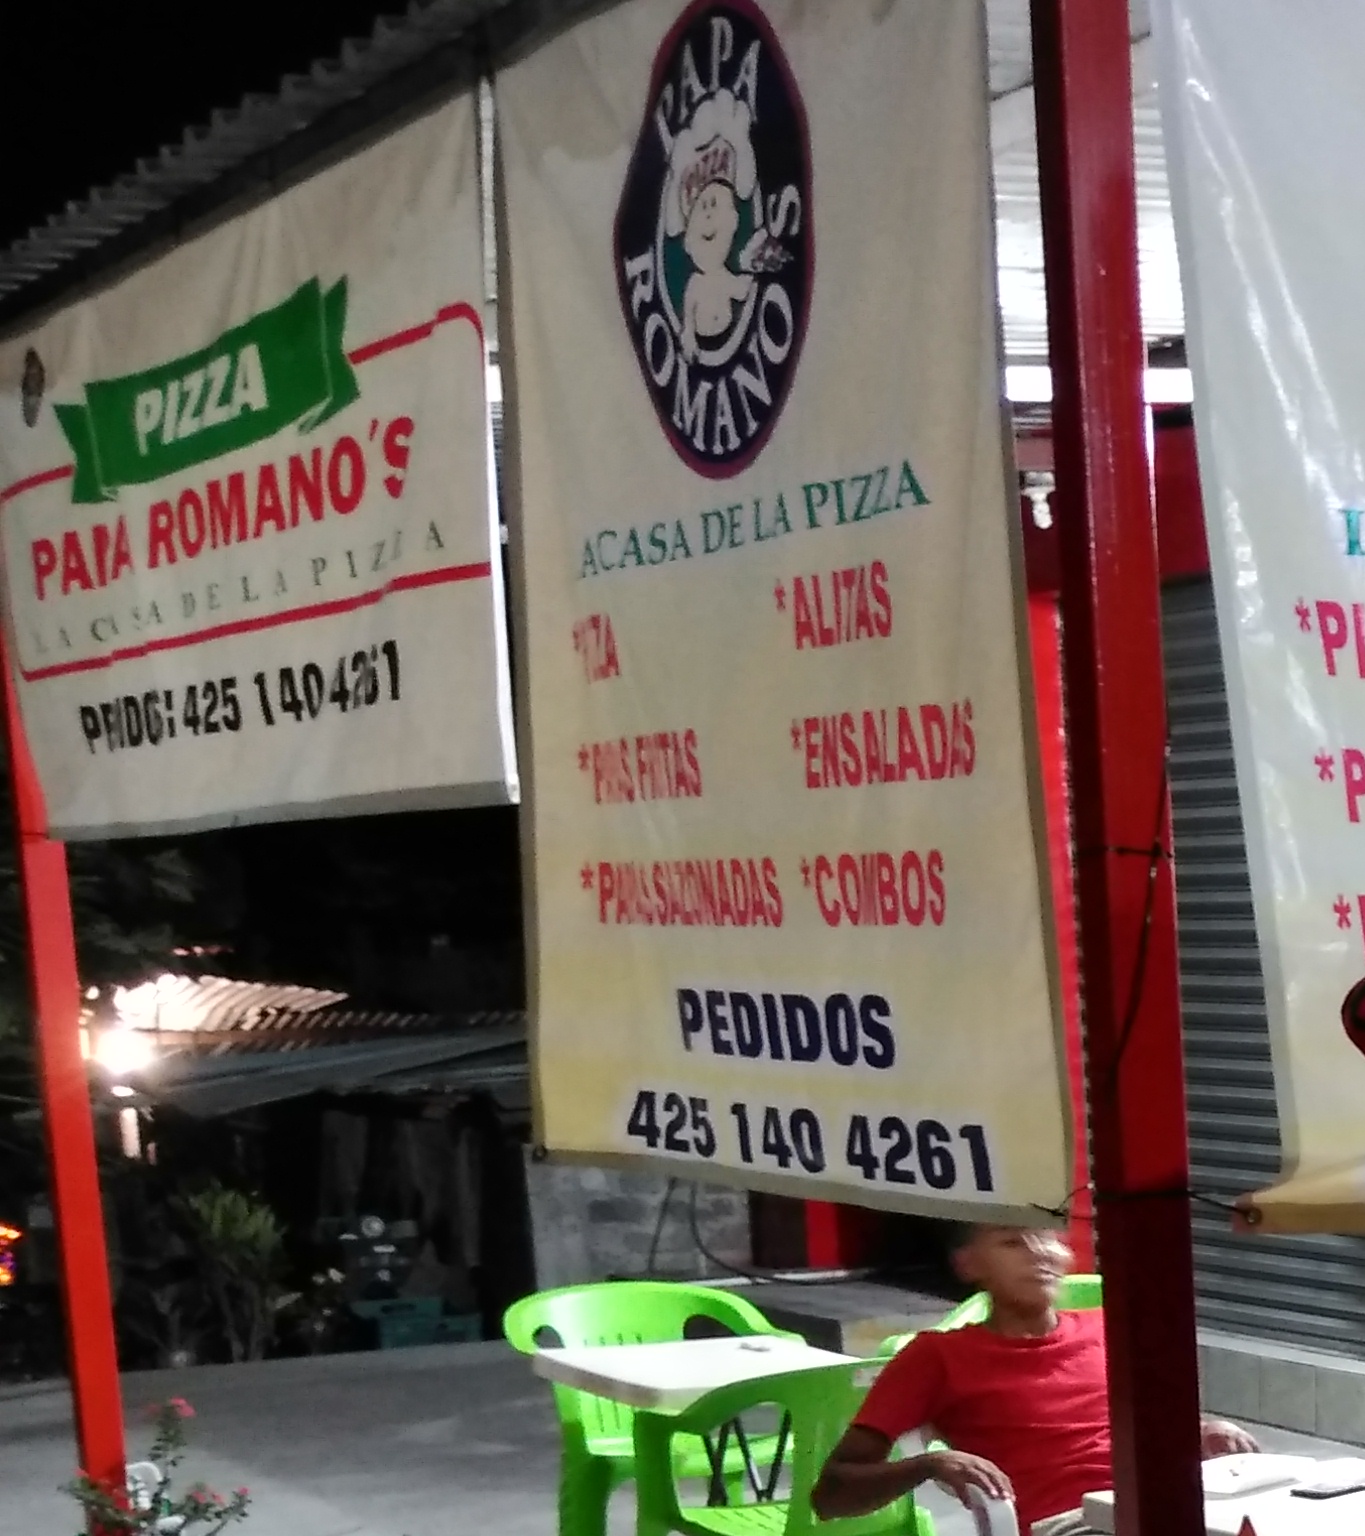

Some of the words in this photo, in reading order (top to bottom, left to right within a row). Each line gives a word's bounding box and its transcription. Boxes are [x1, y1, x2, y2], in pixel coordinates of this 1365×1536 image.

[655, 16, 760, 155] PAPA
[135, 344, 268, 456] PIZZA
[148, 417, 415, 568] ROMANO'S
[700, 504, 745, 553] DE
[753, 492, 794, 542] LA
[802, 459, 931, 529] PIZZA
[242, 570, 288, 603] LA
[184, 677, 243, 736] 425
[254, 662, 324, 726] 140
[677, 989, 895, 1069] PEDIDOS
[627, 1090, 717, 1158] 425
[730, 1103, 826, 1173] 140
[846, 1114, 993, 1192] 4261
